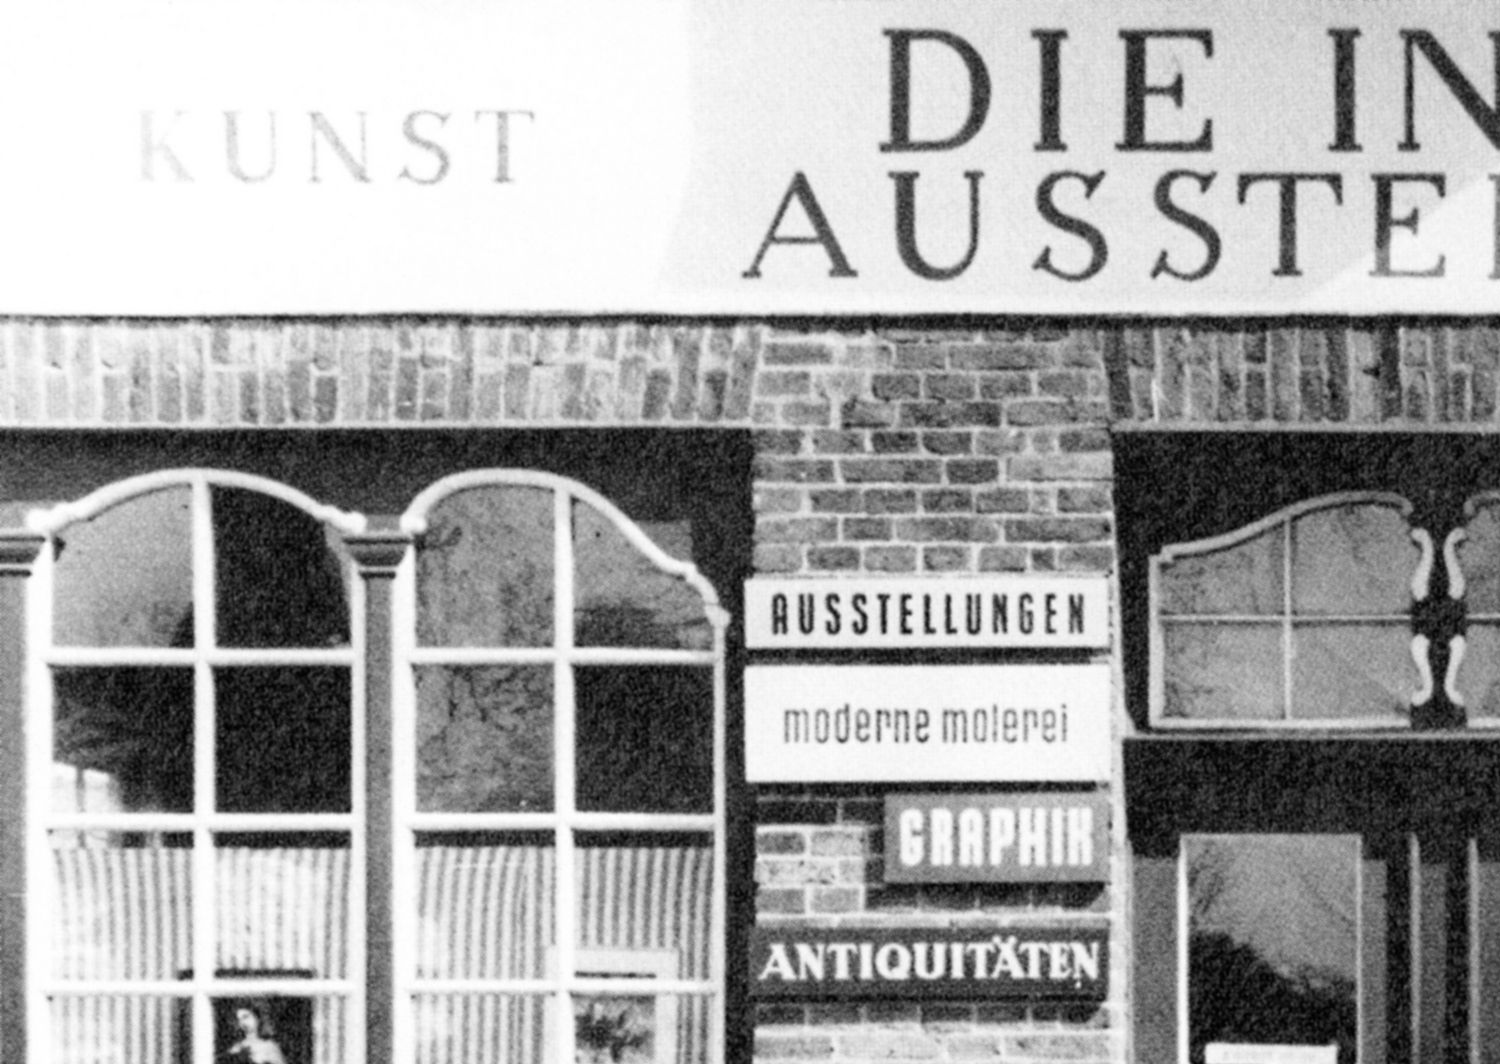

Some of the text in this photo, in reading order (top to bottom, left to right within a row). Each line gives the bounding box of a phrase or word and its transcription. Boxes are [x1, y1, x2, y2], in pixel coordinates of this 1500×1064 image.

[879, 27, 1213, 152] DIE
[140, 108, 537, 187] KUNST
[772, 593, 1085, 635] AUSSTELLUNGEN
[784, 702, 1069, 744] moderne malerei
[899, 806, 1092, 867] GRAPHIK
[759, 934, 1099, 981] ANTIQUITÄTEN
